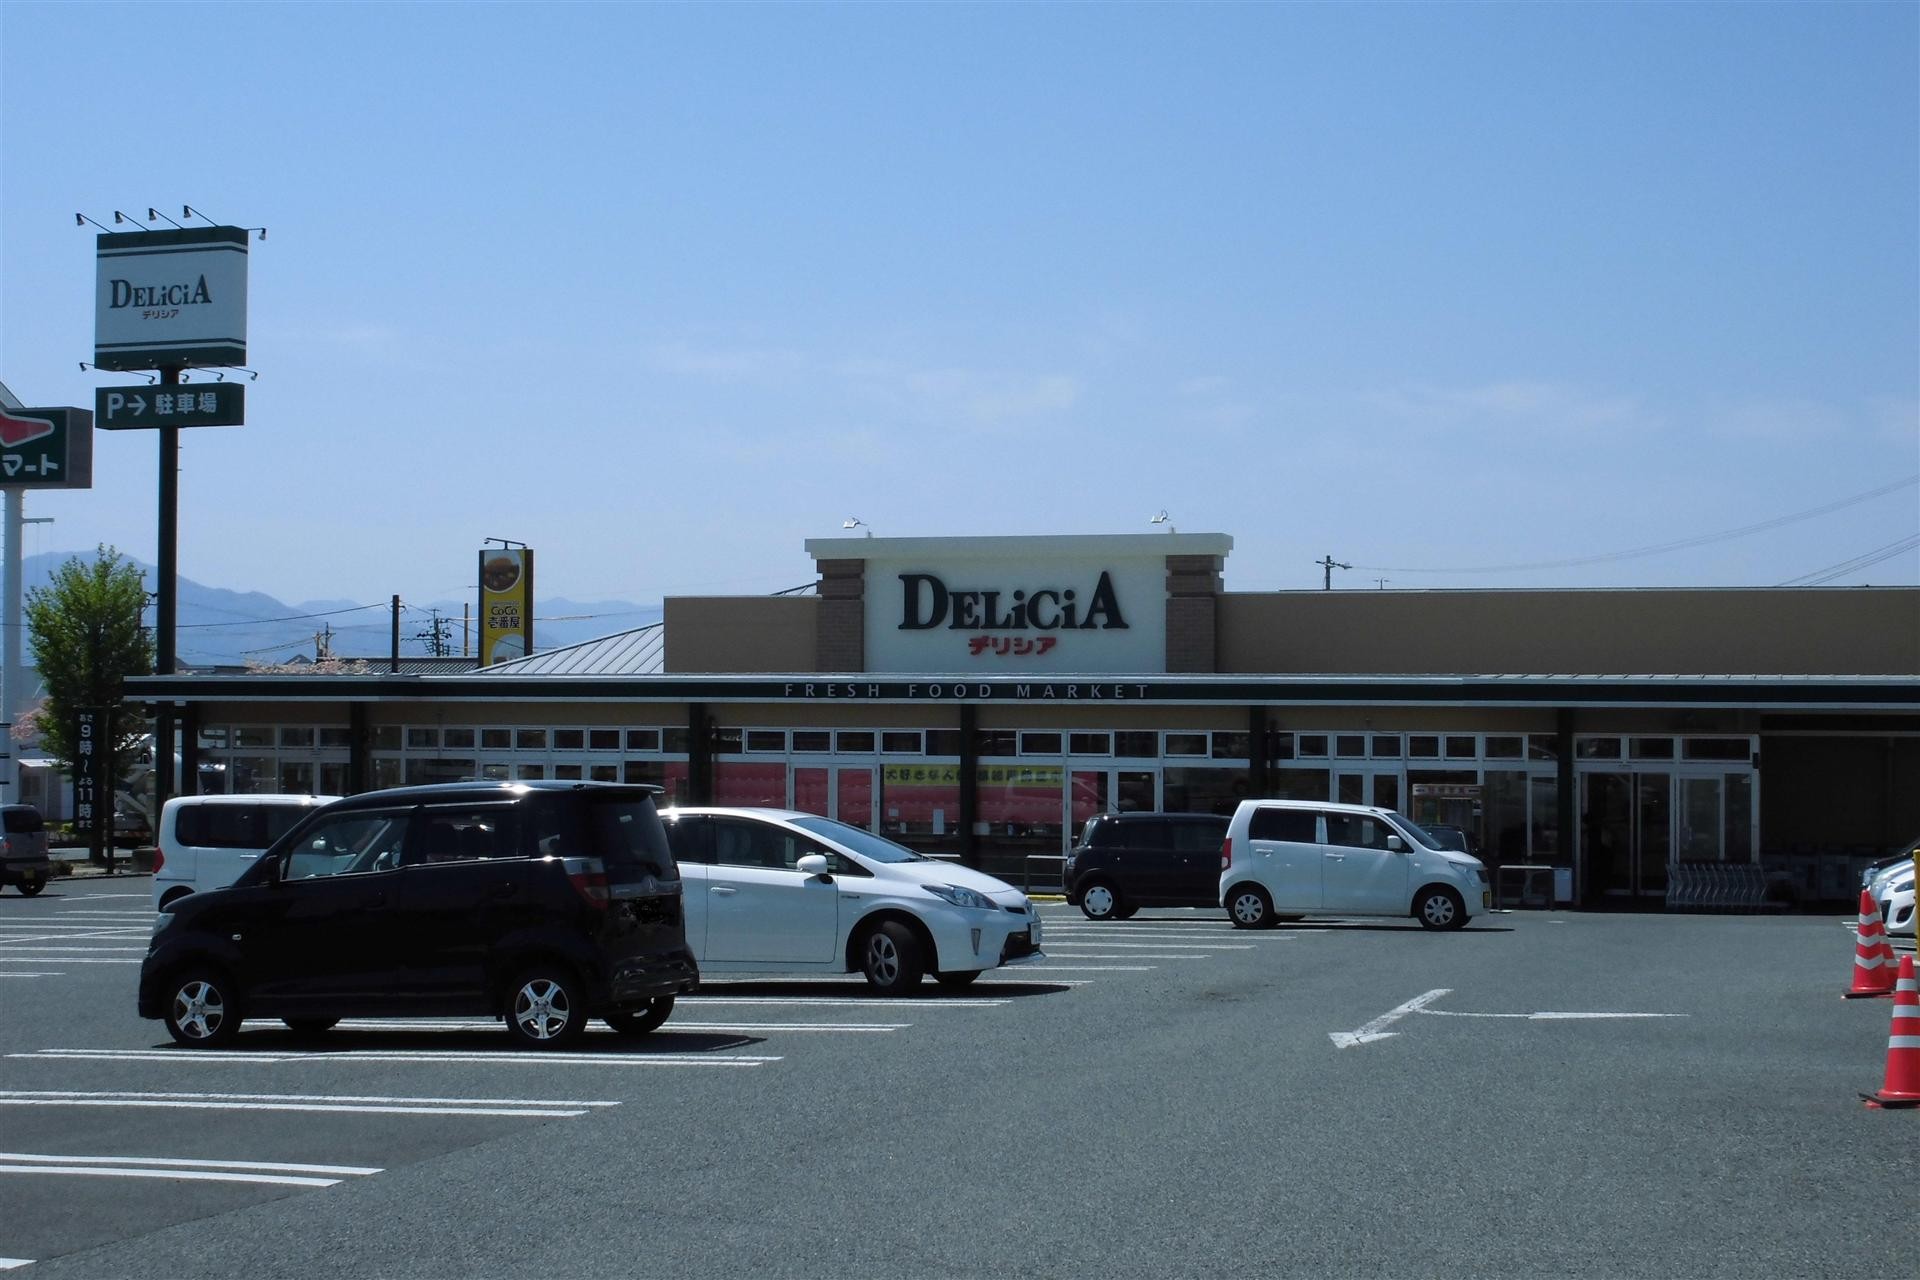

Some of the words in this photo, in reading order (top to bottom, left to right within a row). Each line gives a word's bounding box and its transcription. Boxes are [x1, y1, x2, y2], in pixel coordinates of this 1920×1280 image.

[142, 309, 179, 320] デリシア
[107, 393, 123, 419] P
[155, 393, 217, 414] 駐車場
[2, 453, 59, 476] マート
[968, 636, 1057, 656] デリシア
[785, 684, 880, 697] FRESH
[909, 684, 992, 697] FOOD
[1016, 684, 1148, 698] MARKET
